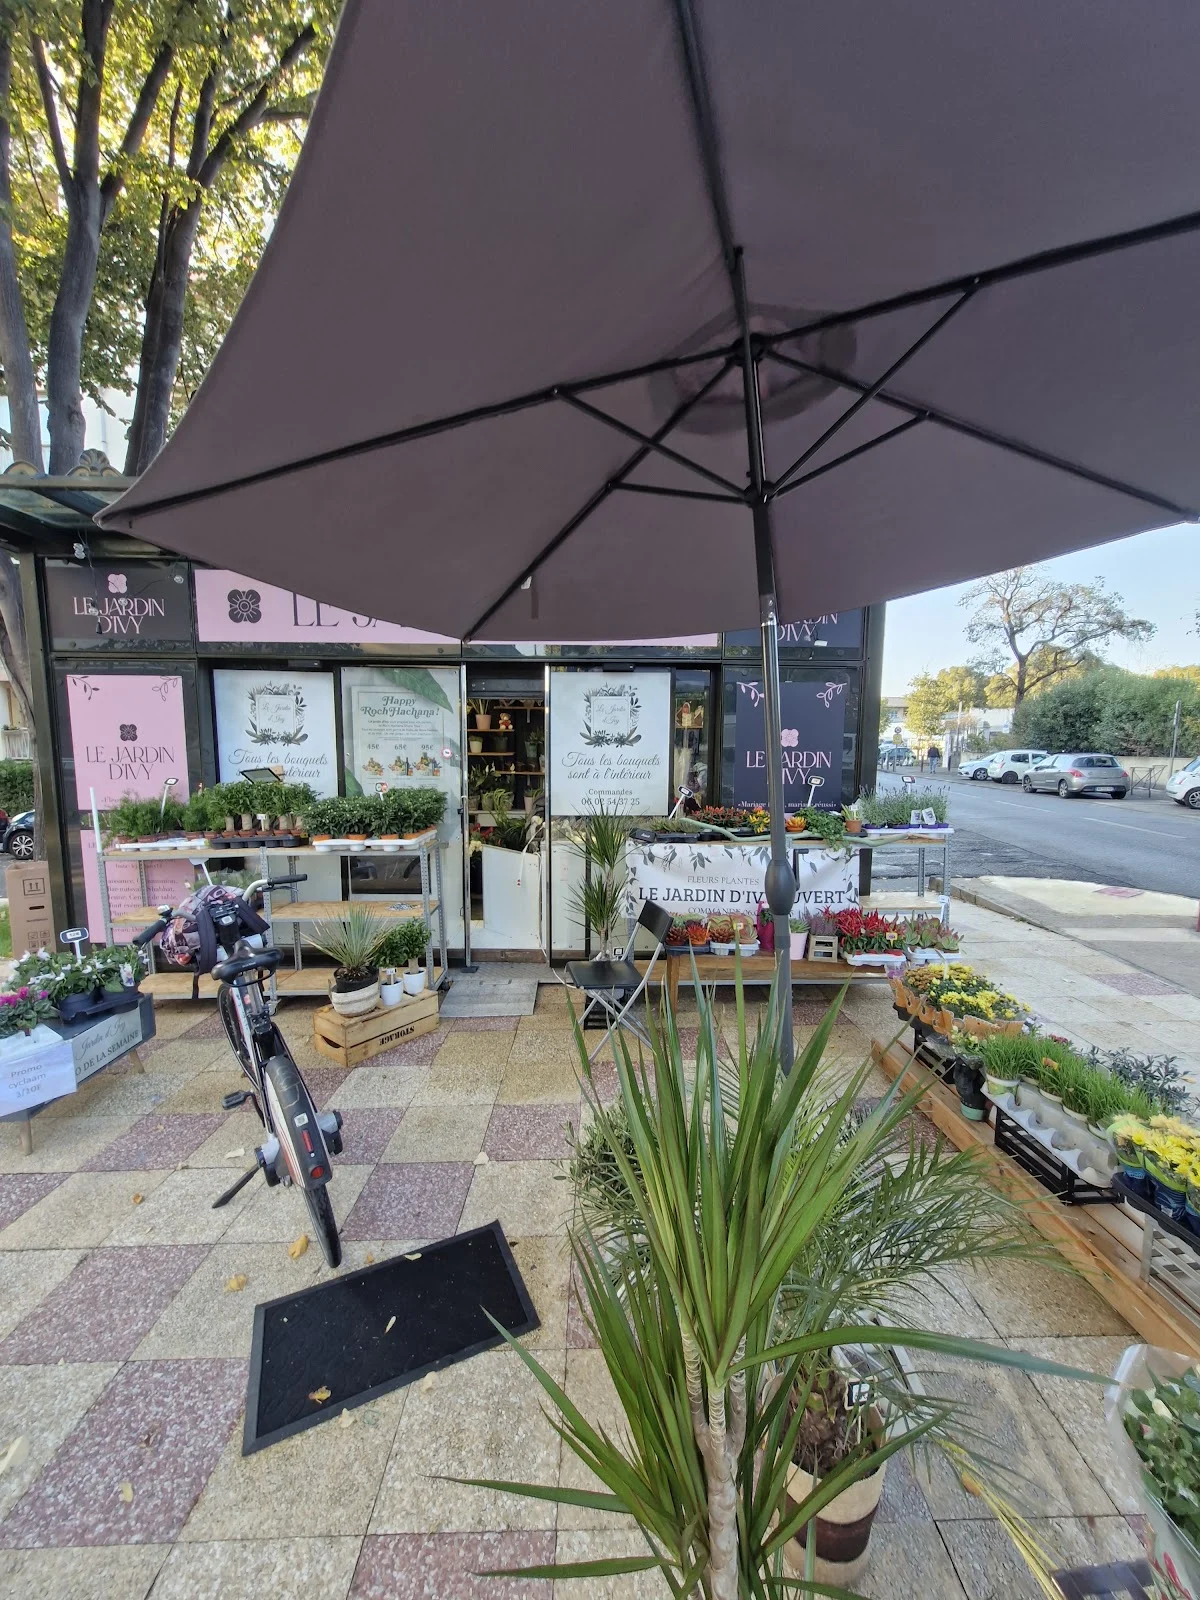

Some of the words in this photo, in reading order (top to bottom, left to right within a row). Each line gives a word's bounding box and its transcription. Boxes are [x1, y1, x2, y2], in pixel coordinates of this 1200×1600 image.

[73, 596, 94, 616] LE
[99, 597, 165, 617] JARDIN
[98, 615, 144, 634] D'IVY
[382, 695, 417, 707] Happy
[86, 746, 106, 763] LE
[111, 746, 175, 764] JARDIN
[228, 748, 262, 765] Tous
[266, 751, 279, 764] les
[284, 752, 328, 767] bouquets
[561, 752, 595, 768] Tous
[599, 753, 612, 765] les
[616, 753, 661, 768] bouquets
[746, 750, 766, 768] LE
[779, 751, 832, 768] ARDIN
[109, 763, 154, 780] D'IVY
[567, 768, 589, 779] sont
[592, 769, 600, 779] à
[603, 767, 652, 779] l'intérieur
[588, 788, 633, 796] Commandes
[630, 797, 641, 806] 25
[687, 876, 719, 885] FLEURS
[721, 877, 760, 887] PLANTES
[639, 887, 658, 901] LE
[662, 887, 724, 903] JARDIN
[729, 890, 767, 904] D'IV
[794, 890, 845, 904] UVERT
[379, 1025, 415, 1046] STORAGE
[83, 1057, 95, 1072] DE
[96, 1051, 107, 1063] LA
[107, 1029, 140, 1056] SEMAINE
[10, 1064, 43, 1078] Promo
[8, 1073, 47, 1090] cyclaam
